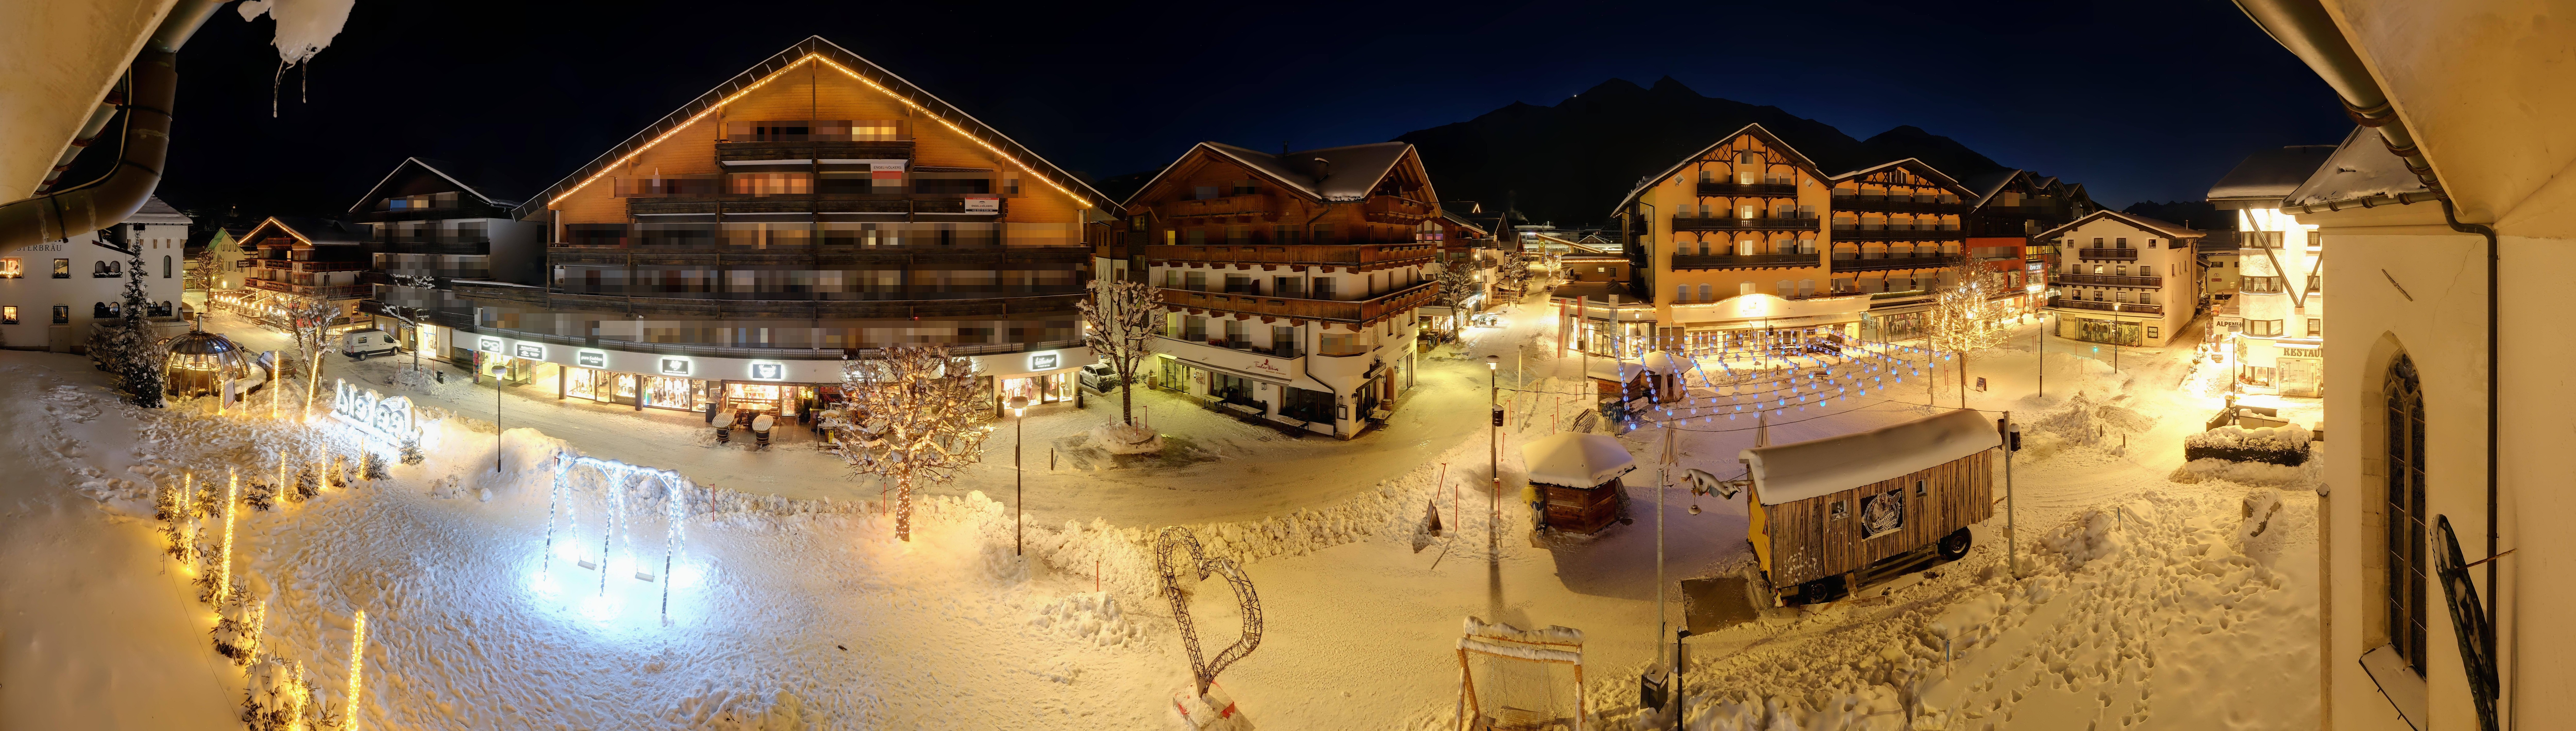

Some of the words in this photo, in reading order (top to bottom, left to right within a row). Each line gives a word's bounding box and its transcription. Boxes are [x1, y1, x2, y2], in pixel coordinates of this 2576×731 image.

[1402, 343, 1410, 351] SAILER
[1371, 364, 1385, 377] RESTAURANT
[1875, 513, 1893, 528] Höpfeler
[1883, 519, 1896, 531] Hexen
